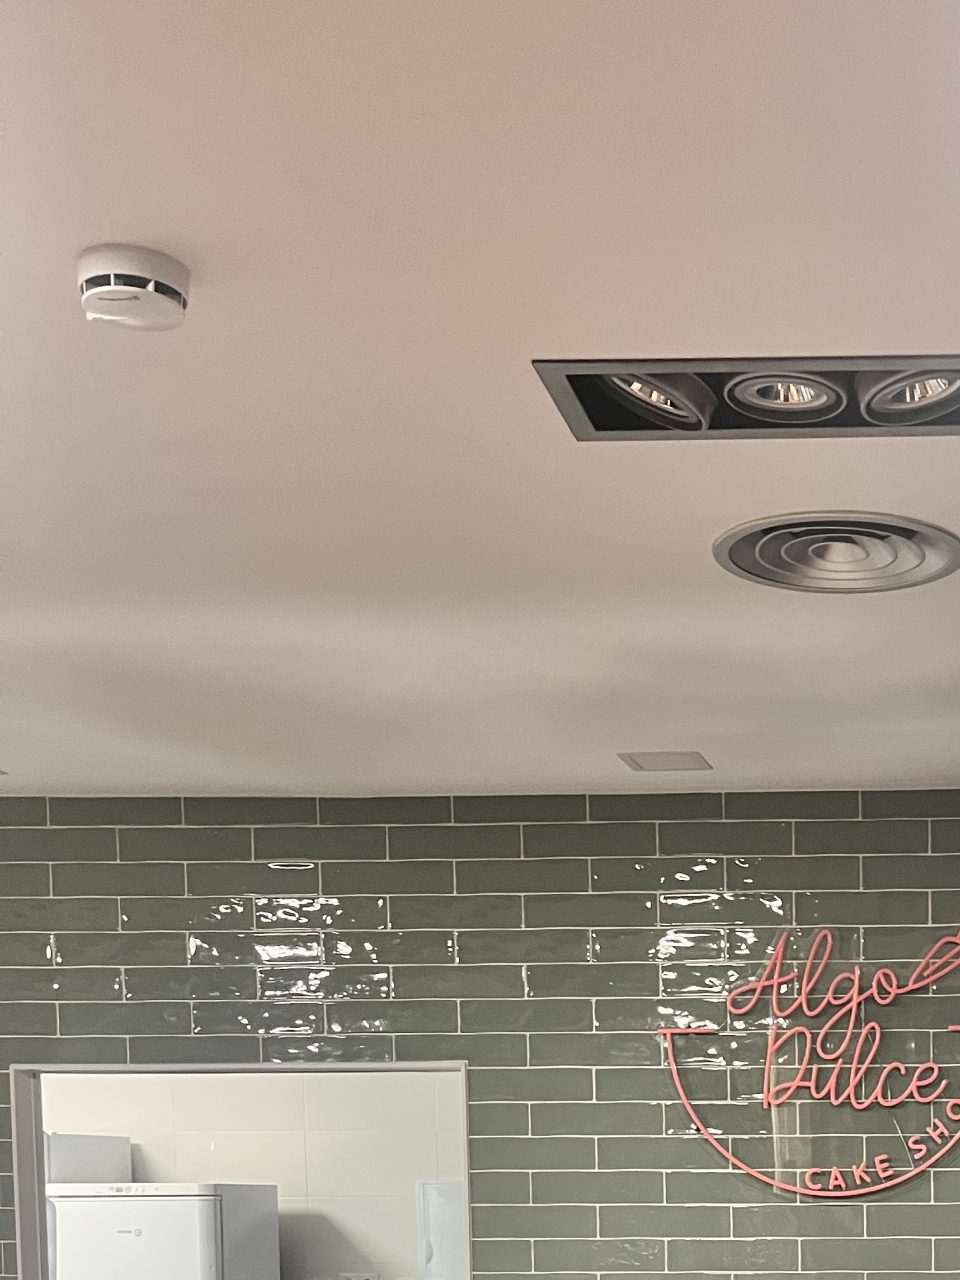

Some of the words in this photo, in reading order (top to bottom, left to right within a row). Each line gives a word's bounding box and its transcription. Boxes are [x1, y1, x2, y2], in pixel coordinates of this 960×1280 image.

[727, 929, 898, 1060] Algo
[762, 1021, 949, 1109] Dulce
[803, 1153, 895, 1192] CAKE
